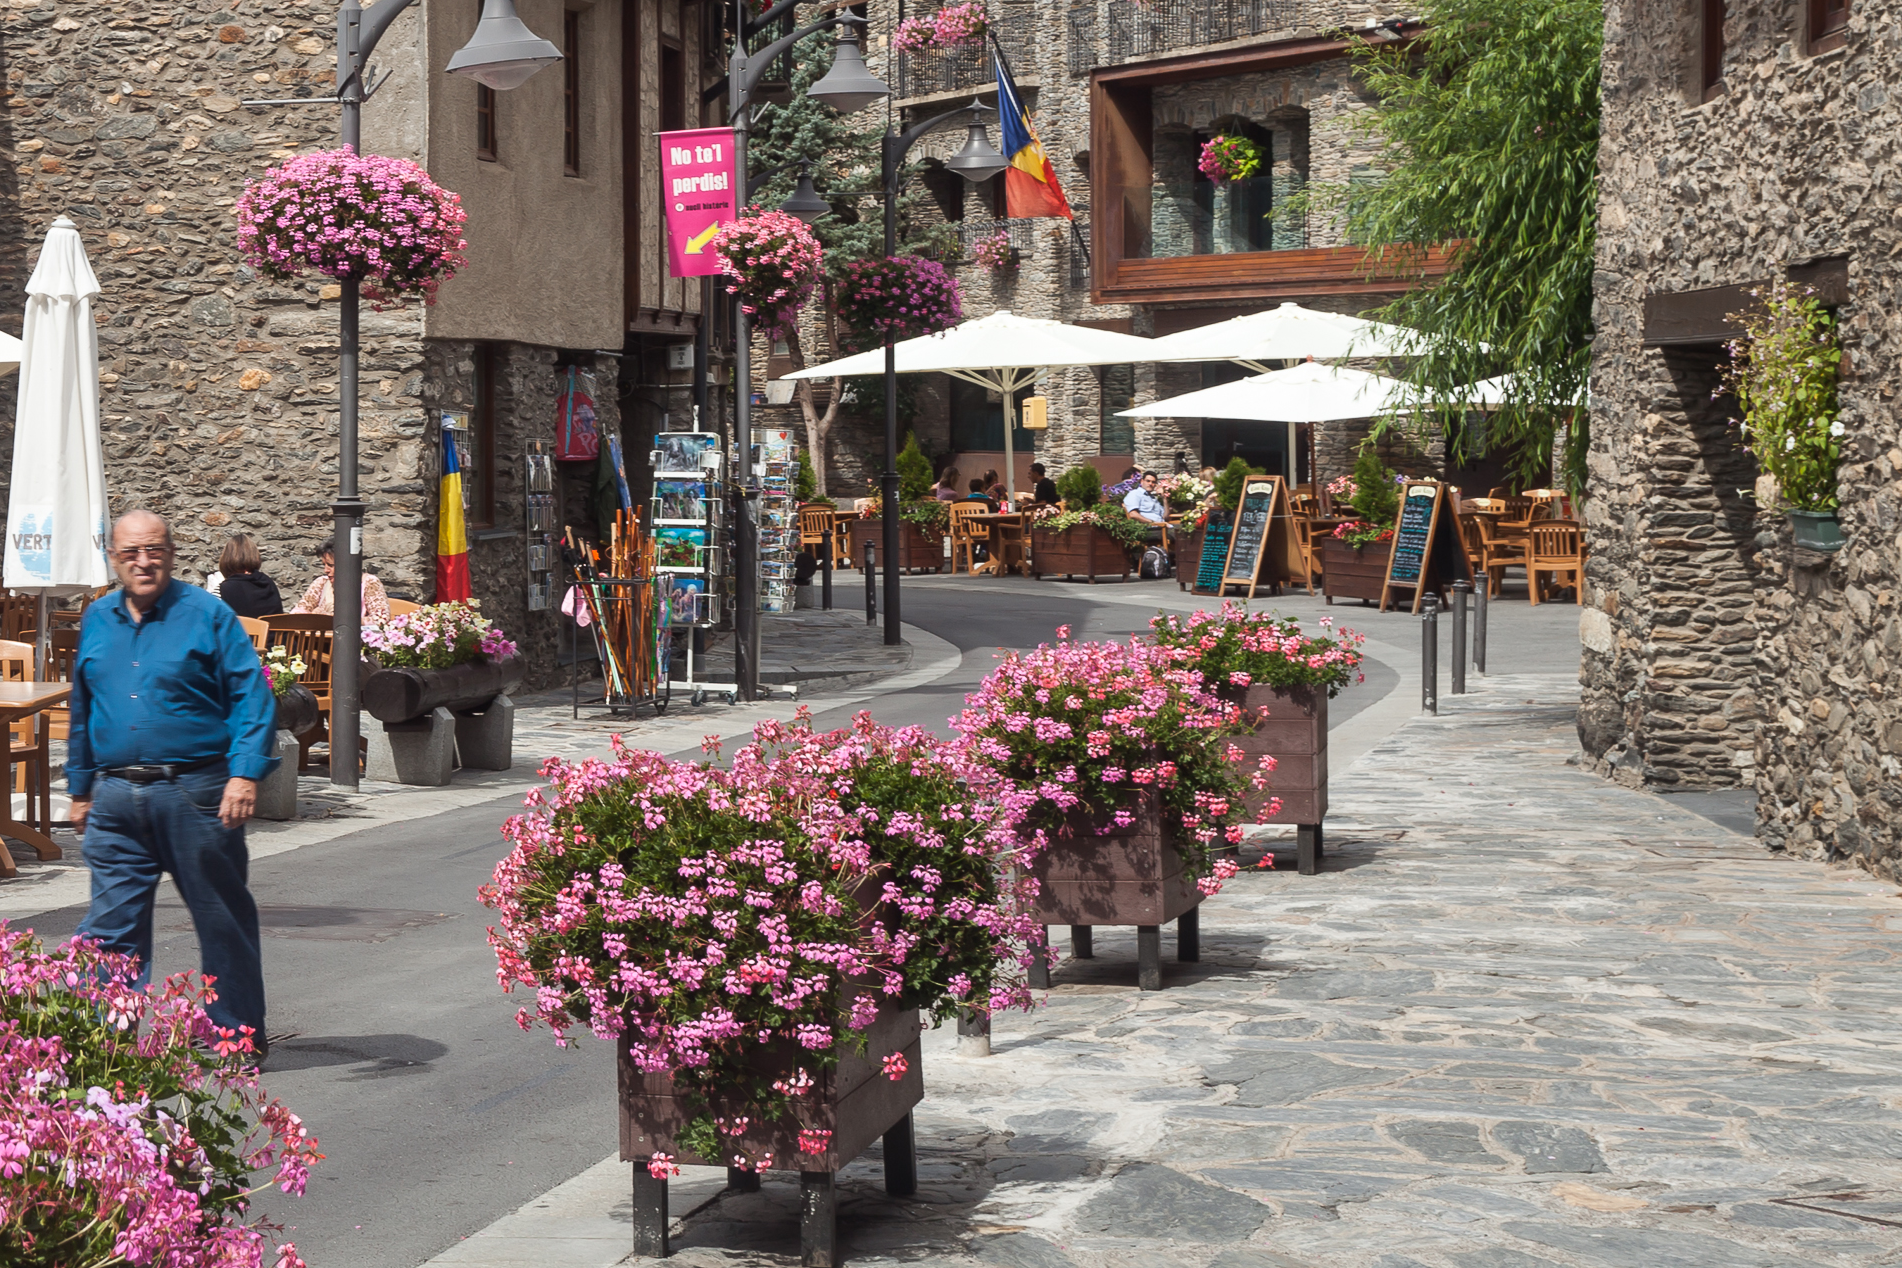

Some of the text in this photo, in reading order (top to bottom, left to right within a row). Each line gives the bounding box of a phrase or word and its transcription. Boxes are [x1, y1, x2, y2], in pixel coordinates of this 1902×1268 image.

[670, 143, 722, 166] No te'l
[672, 171, 729, 197] perdis!
[12, 533, 52, 550] VERT
